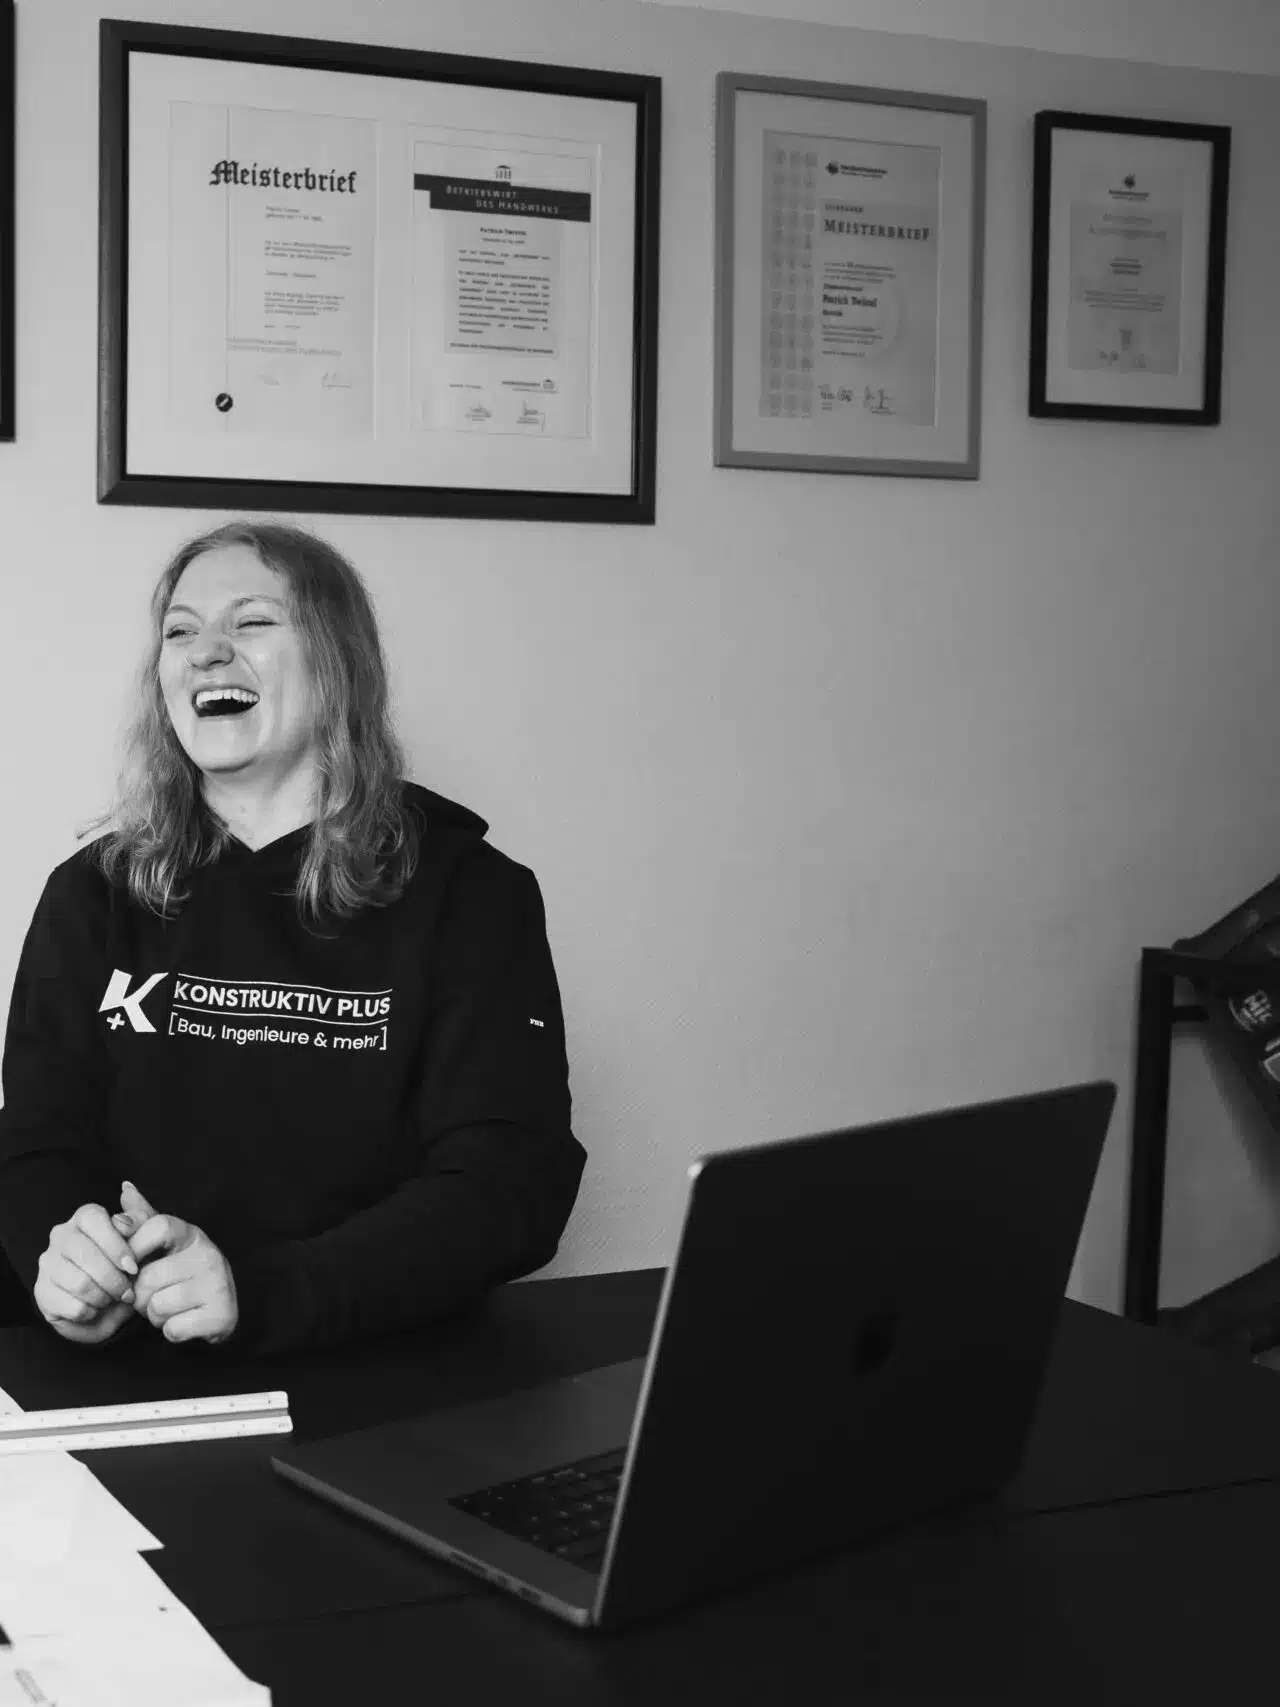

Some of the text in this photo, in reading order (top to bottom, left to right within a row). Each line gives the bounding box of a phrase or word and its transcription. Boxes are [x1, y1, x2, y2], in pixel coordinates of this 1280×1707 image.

[209, 159, 358, 194] Meisterbrief
[446, 184, 517, 198] BETRIEBSWIRT
[476, 199, 559, 214] DES HANDWERKS
[824, 218, 930, 240] MEISTERBRIEF
[173, 980, 391, 1018] KONSTRUKTIV PLUS
[221, 1024, 310, 1045] Ingenieure
[313, 1032, 328, 1048] &
